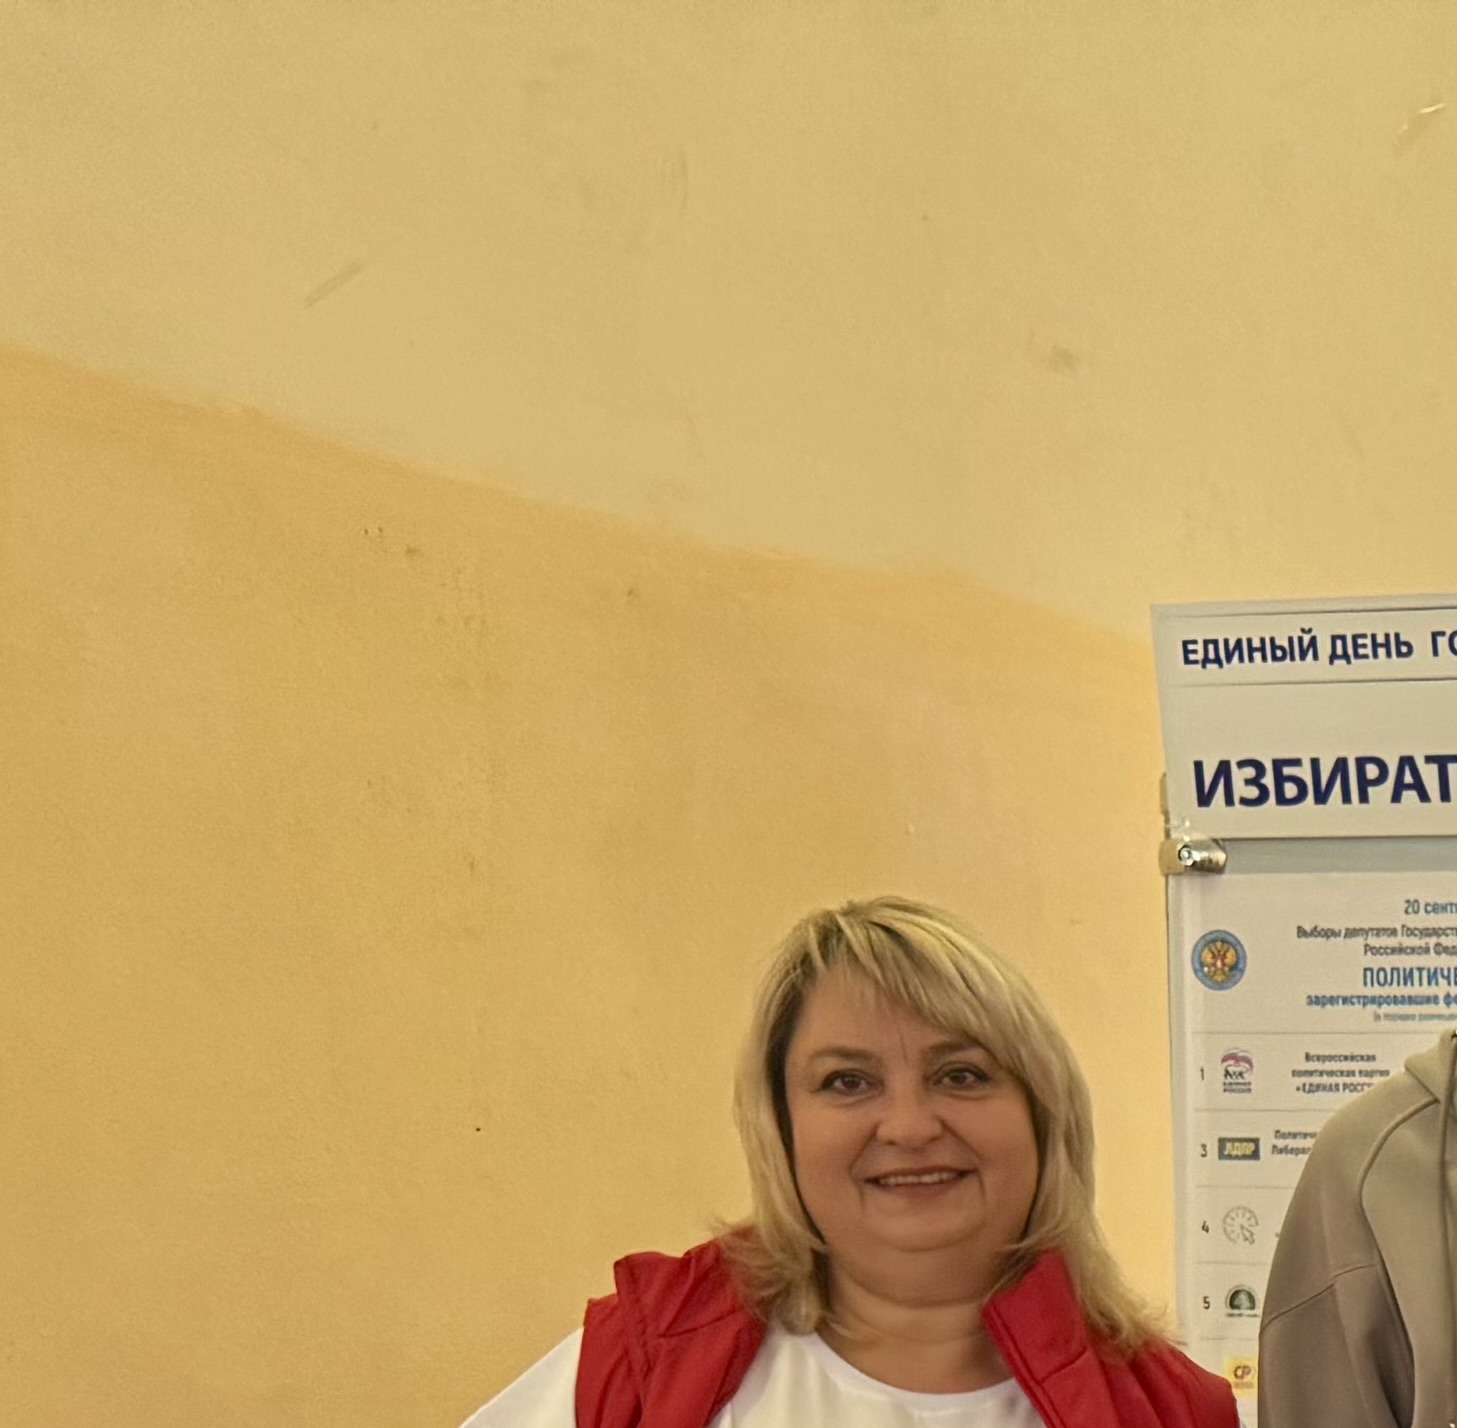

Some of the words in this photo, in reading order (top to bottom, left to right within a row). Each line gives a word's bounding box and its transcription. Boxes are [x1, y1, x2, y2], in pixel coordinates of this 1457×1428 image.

[1182, 628, 1319, 669] ЕДИНЫЙ
[1328, 632, 1414, 665] ДЕНЬ
[1404, 899, 1420, 915] 20
[1200, 1144, 1207, 1158] 3
[1203, 1295, 1211, 1310] 5
